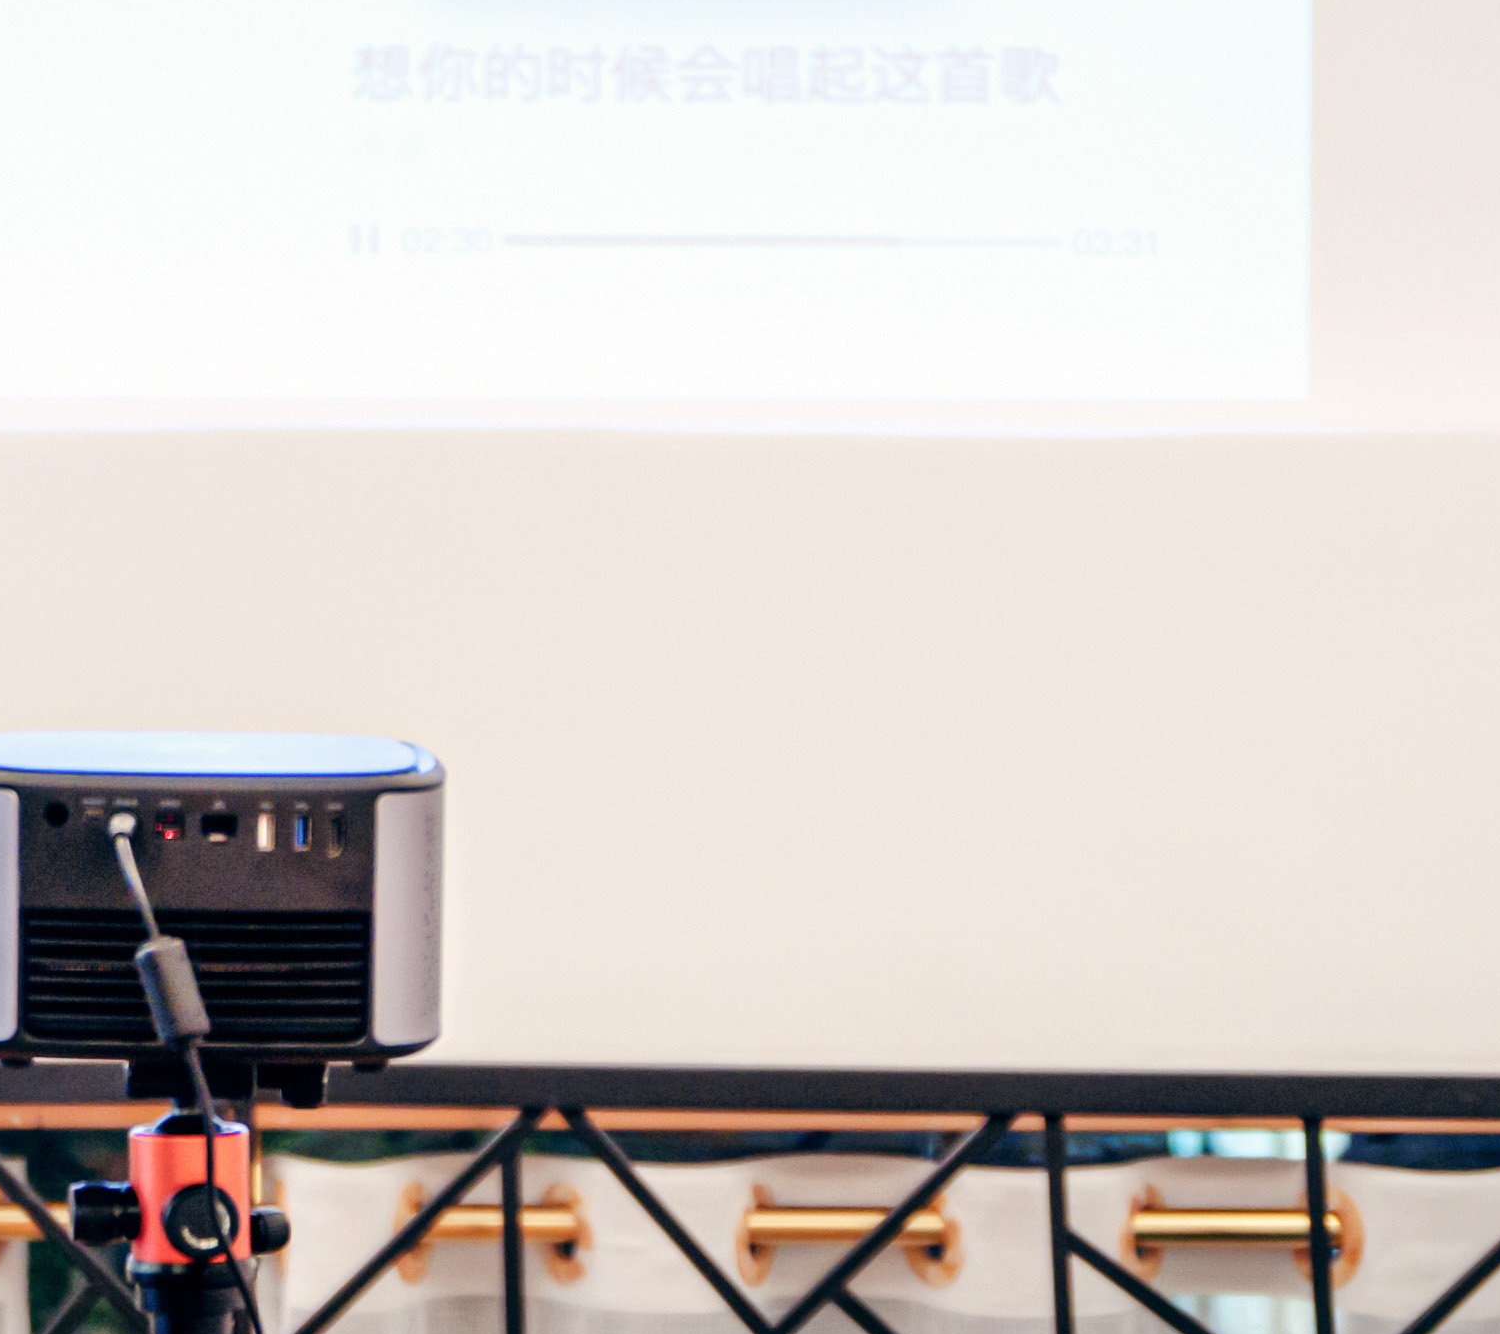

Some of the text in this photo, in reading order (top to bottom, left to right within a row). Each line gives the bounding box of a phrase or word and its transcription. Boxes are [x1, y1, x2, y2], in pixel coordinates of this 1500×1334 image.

[351, 41, 1062, 107] 想你的时候会唱起这首歌
